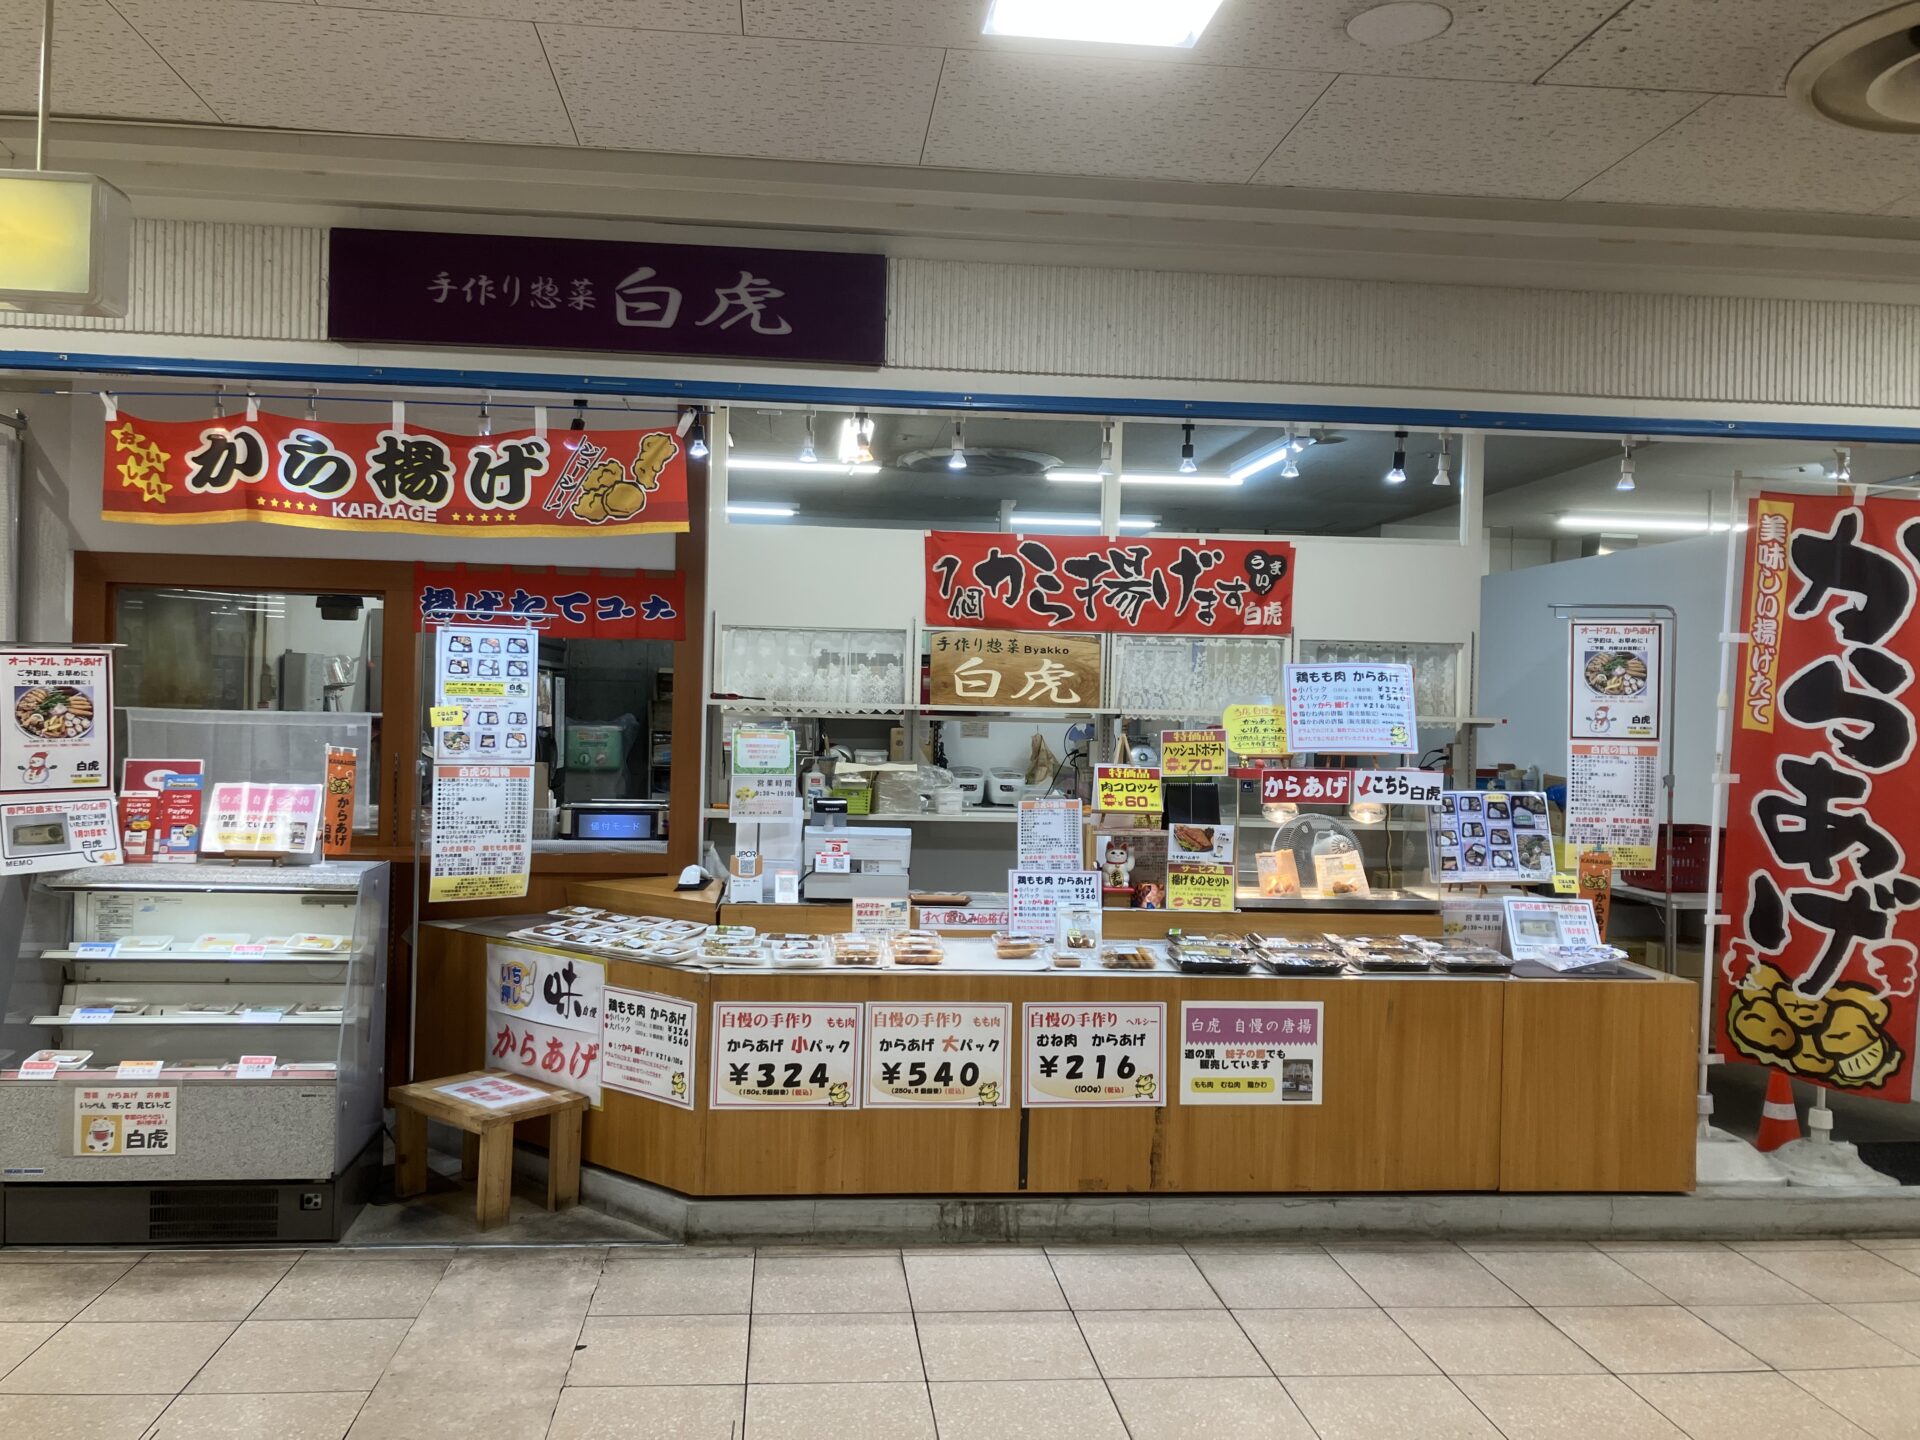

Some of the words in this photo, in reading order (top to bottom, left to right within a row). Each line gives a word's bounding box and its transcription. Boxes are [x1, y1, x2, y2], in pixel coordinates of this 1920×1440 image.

[426, 270, 597, 312] 手作り惣菜
[614, 266, 793, 336] 白虎
[120, 431, 164, 496] おいしい
[185, 425, 549, 511] から揚げ
[332, 502, 437, 523] KARAAGE
[1243, 601, 1283, 626] 白虎
[1749, 515, 1787, 725] 美味しい揚げたて
[936, 636, 1020, 654] 手作り惣菜
[1024, 645, 1069, 655] Byakko
[954, 656, 1081, 704] 白虎
[1296, 671, 1346, 683] 鶏もも肉
[1353, 671, 1399, 683] からあげ
[1632, 715, 1651, 724] 白虎
[1173, 731, 1216, 742] 特価品
[1163, 743, 1225, 757] ハッシュドポテト
[1745, 506, 1920, 1000] からあげ
[76, 760, 100, 772] 白虎
[1108, 768, 1150, 779] 特価品
[757, 779, 792, 787] 営業時間
[1101, 782, 1158, 793] 肉コロッケ
[1264, 775, 1348, 799] からあげ
[1372, 775, 1409, 795] こちら
[1410, 786, 1441, 801] 白虎
[335, 796, 350, 847] からあげ
[82, 839, 103, 849] 白虎
[5, 859, 33, 868] MEMO
[1181, 864, 1225, 874] サービス品
[1018, 875, 1054, 885] 鶏もも肉
[1057, 876, 1093, 885] からあげ
[1172, 874, 1230, 887] 揚げものセット
[1465, 914, 1500, 922] 営業時間
[543, 960, 584, 1020] 味
[608, 998, 646, 1018] 鶏もも肉
[650, 1007, 687, 1027] からあげ
[722, 1012, 812, 1029] 自慢の手作り
[826, 1017, 855, 1029] もも肉
[874, 1011, 962, 1028] 自慢の手作り
[972, 1016, 1000, 1027] もも肉
[1031, 1012, 1118, 1028] 自慢の手作り
[1126, 1018, 1158, 1026] ヘルシー
[668, 1025, 689, 1038] ¥324
[1191, 1018, 1222, 1034] 白虎
[1235, 1018, 1313, 1034] 自慢の唐揚
[668, 1034, 689, 1048] ¥540
[727, 1038, 784, 1053] からあげ
[791, 1035, 850, 1054] 小パック
[879, 1037, 935, 1052] からあげ
[942, 1035, 1000, 1053] 大パック
[1036, 1033, 1078, 1047] むね肉
[1091, 1033, 1146, 1047] からあげ
[492, 1023, 600, 1080] からあげ
[1184, 1049, 1216, 1059] 道の駅
[1039, 1054, 1136, 1080] ¥216
[1200, 1059, 1271, 1070] 販売しています
[729, 1062, 830, 1088] ¥324
[882, 1061, 980, 1087] ¥540
[1074, 1085, 1102, 1093] (100g)
[1194, 1081, 1214, 1089] もも肉
[1220, 1081, 1241, 1089] むね肉
[136, 1101, 172, 1109] 見ていって
[126, 1128, 169, 1149] 白虎
